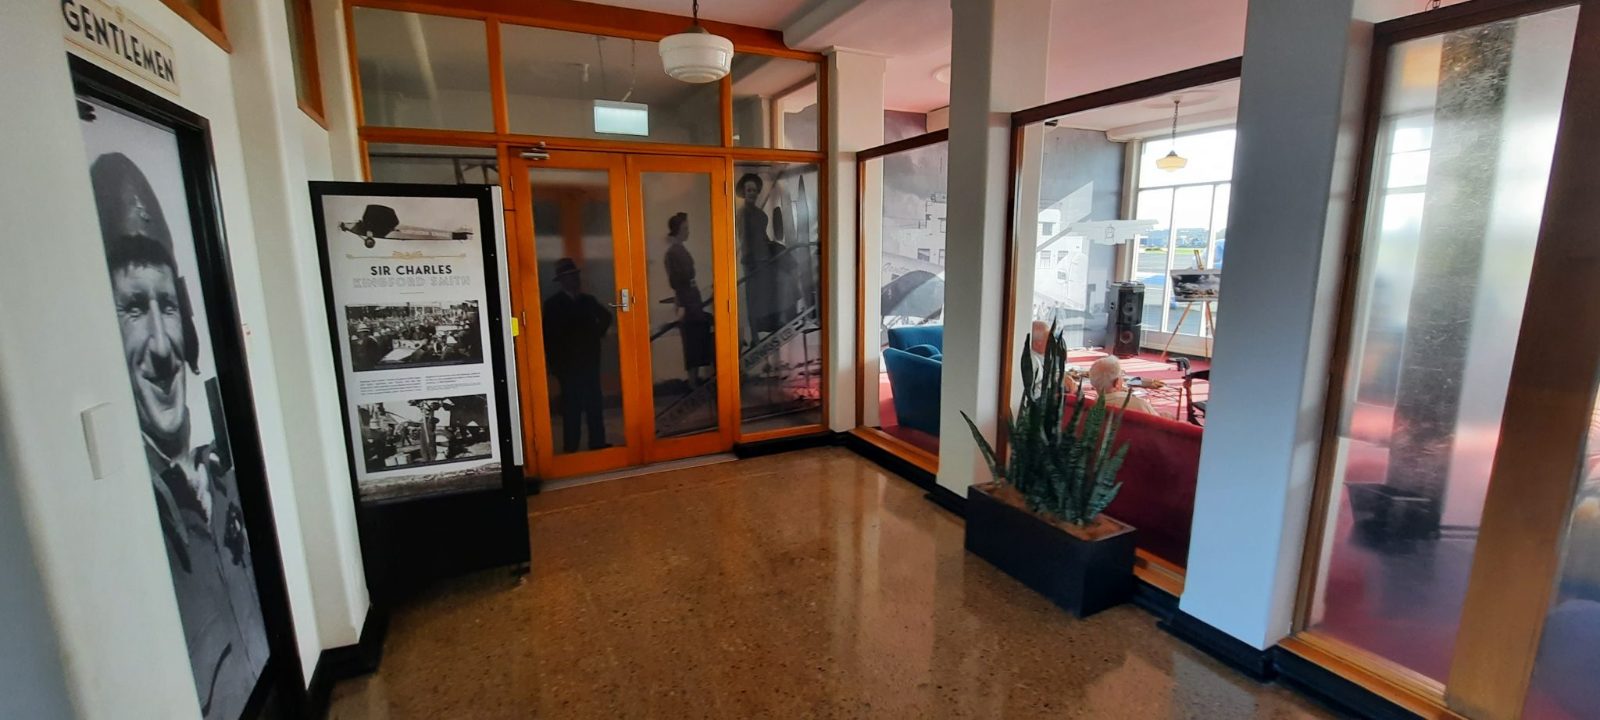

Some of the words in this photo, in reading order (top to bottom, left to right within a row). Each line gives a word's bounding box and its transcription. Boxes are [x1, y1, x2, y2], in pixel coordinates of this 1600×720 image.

[62, 0, 175, 84] GENTLEMEN
[370, 265, 391, 276] SIR
[396, 264, 452, 276] CHARLES
[352, 276, 426, 289] KINGSFORD
[430, 275, 471, 287] SMITH
